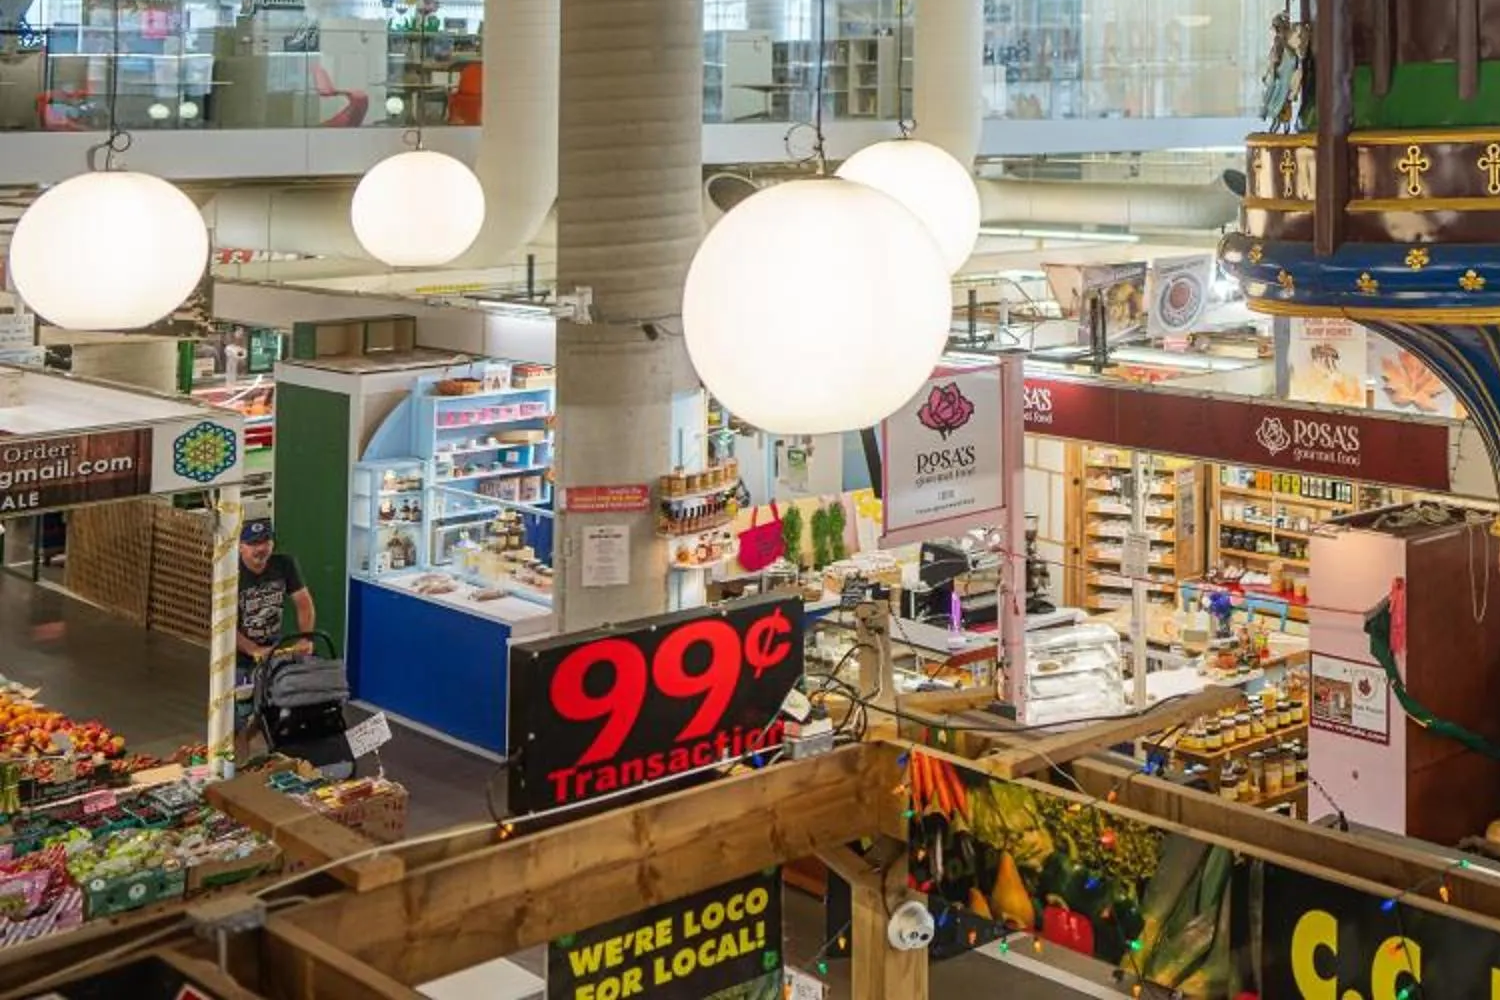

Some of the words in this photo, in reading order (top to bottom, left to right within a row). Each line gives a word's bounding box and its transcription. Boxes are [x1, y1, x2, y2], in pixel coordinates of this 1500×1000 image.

[1293, 419, 1360, 452] ROSA'S
[4, 442, 78, 463] Order:
[916, 445, 976, 475] ROSA'S
[1337, 451, 1360, 466] food
[547, 718, 786, 804] Transaction
[568, 917, 673, 978] WE'RE
[683, 886, 770, 939] LOCO
[574, 966, 644, 1000] FOR
[653, 920, 767, 986] LOCAL!
